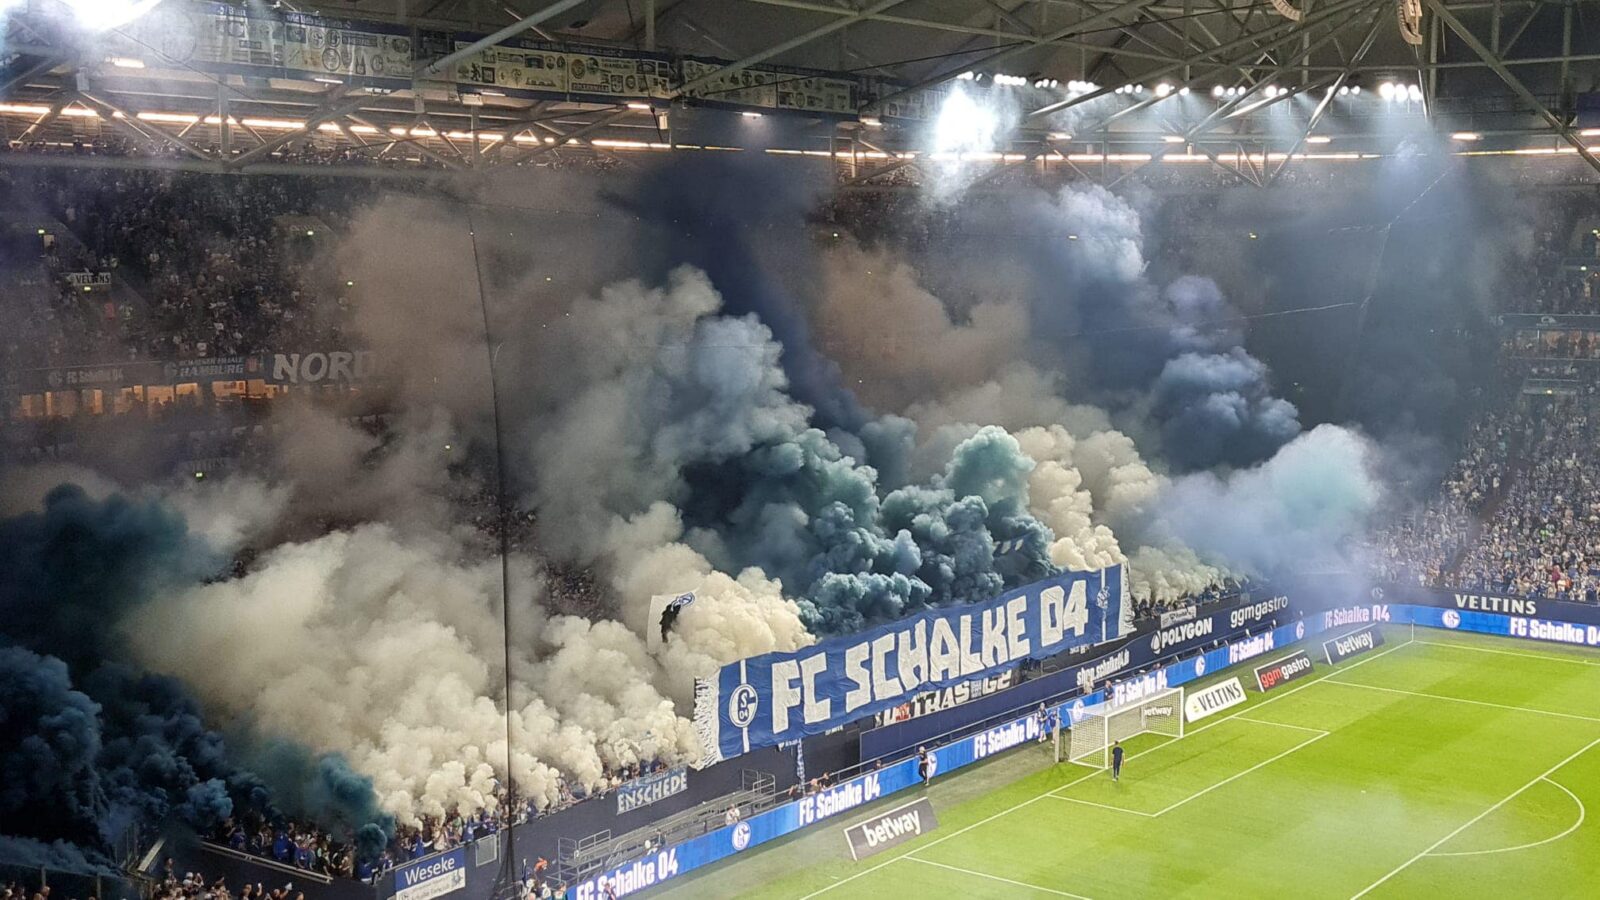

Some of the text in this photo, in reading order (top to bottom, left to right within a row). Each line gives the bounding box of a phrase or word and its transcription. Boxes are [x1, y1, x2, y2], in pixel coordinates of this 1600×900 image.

[75, 273, 110, 284] VELINS
[1230, 595, 1289, 628] ggmgastro
[1333, 605, 1370, 627] Schalke
[1455, 593, 1537, 615] VELTINS
[1161, 617, 1213, 649] POLYGON
[1335, 631, 1374, 656] betway
[1510, 616, 1527, 636] FC
[1529, 619, 1585, 644] Schalke
[771, 580, 1089, 735] FC SCHALKE 04
[1260, 657, 1310, 688] ggmgastro
[883, 681, 971, 726] UTRAS
[1197, 682, 1242, 711] VELTINS
[974, 713, 1041, 760] FC Schalke 04
[617, 772, 688, 813] ENSCHEDE
[799, 773, 881, 827] FC Schalke 04
[862, 810, 921, 848] betway
[404, 856, 455, 886] Weseke
[576, 847, 680, 900] FC Schalke 04
